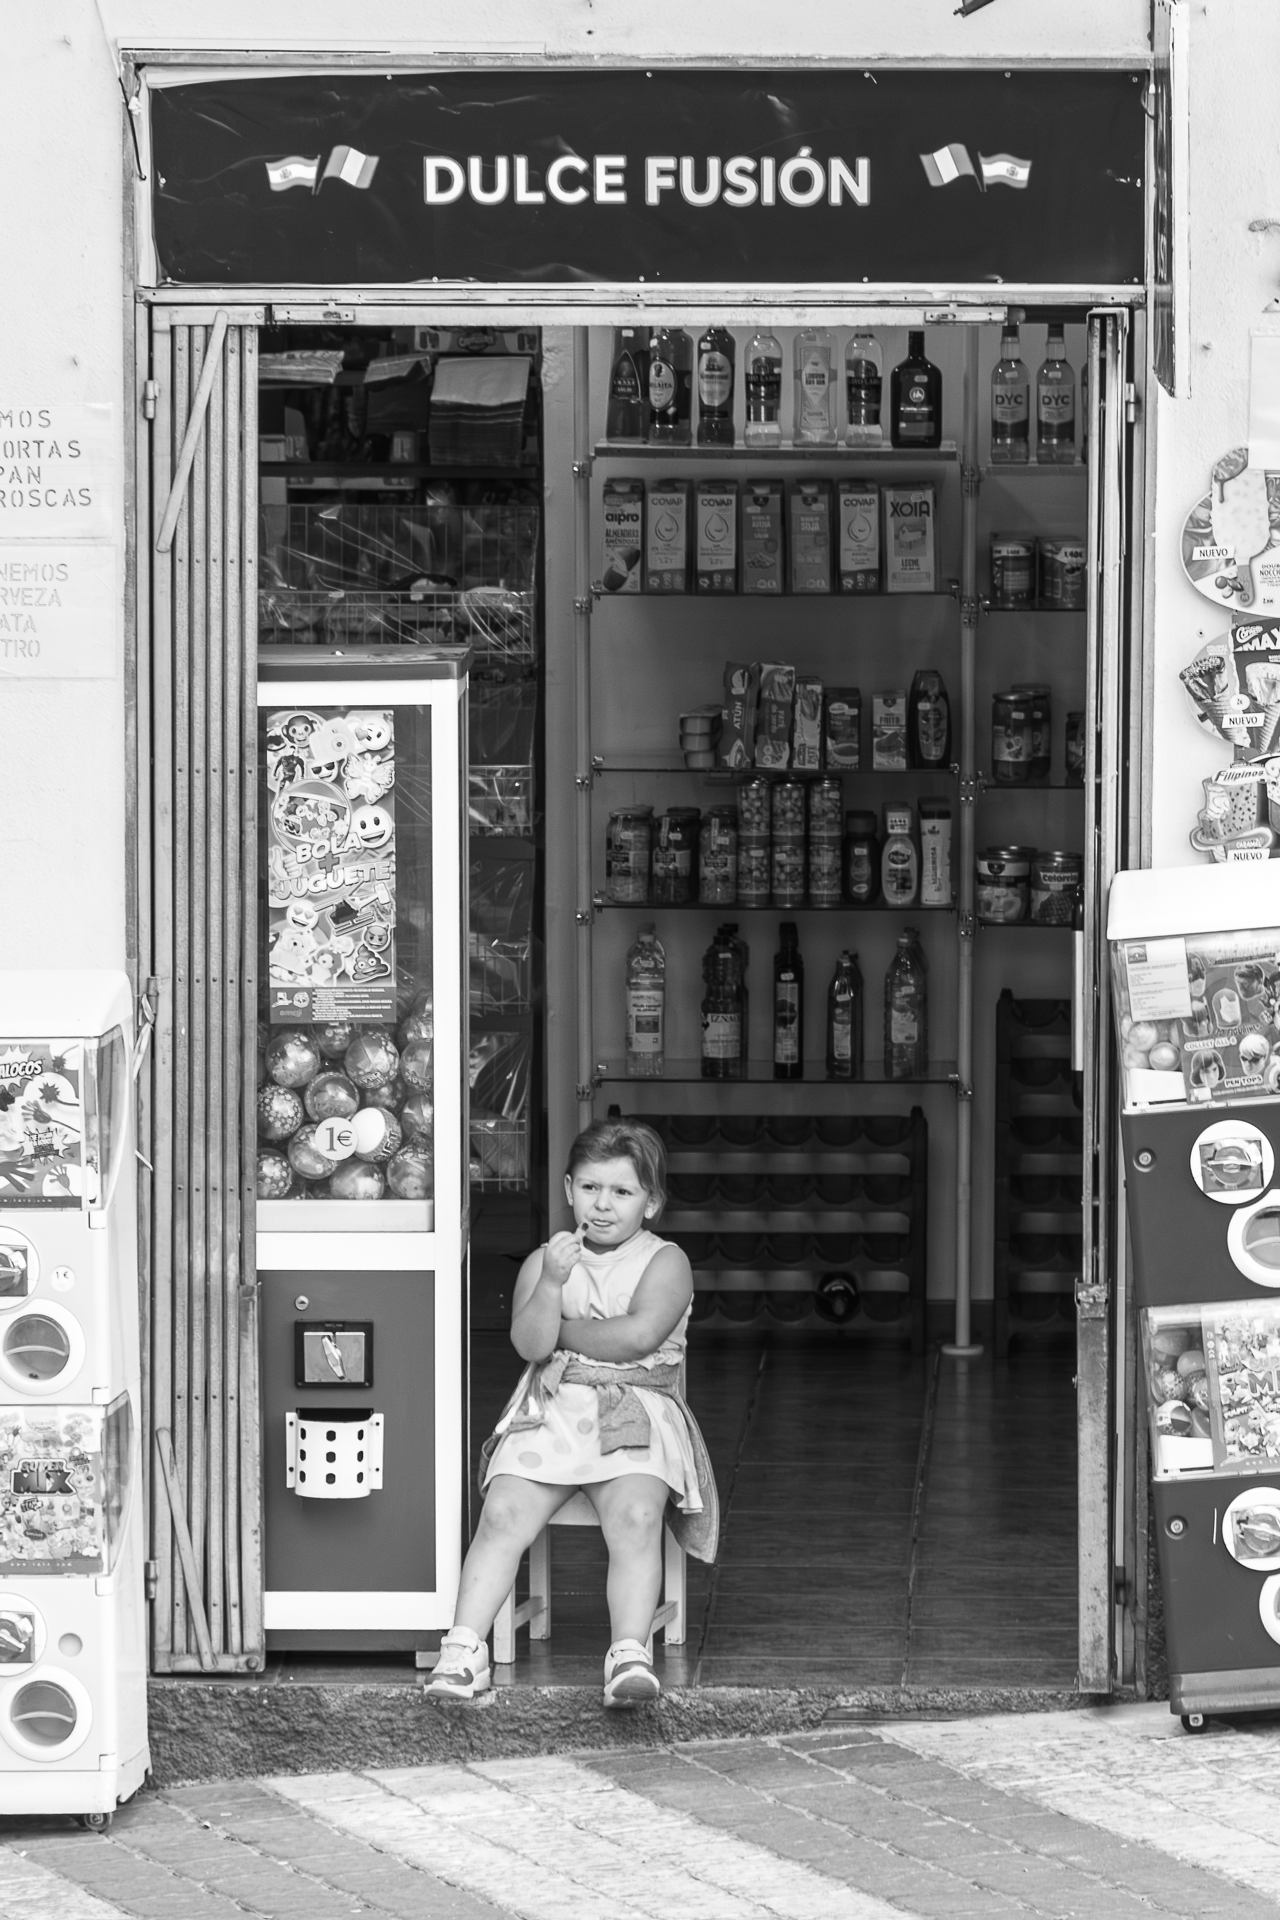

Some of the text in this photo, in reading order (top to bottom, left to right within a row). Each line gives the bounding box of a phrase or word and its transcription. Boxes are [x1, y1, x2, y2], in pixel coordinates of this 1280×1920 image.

[423, 146, 870, 206] DULCE FUSIÓN
[995, 394, 1023, 406] DYC
[1042, 394, 1071, 406] DYC
[0, 409, 51, 428] MOS
[3, 440, 81, 458] ORTAS
[650, 497, 683, 506] COVAP
[701, 498, 733, 507] COVAP
[843, 498, 876, 507] COVAP
[1199, 548, 1228, 558] NUEVO
[1228, 716, 1259, 725] NUEVO
[1215, 769, 1265, 782] Filipinos
[295, 831, 363, 864] BOLA
[1232, 852, 1263, 861] NUEVO
[274, 862, 391, 901] JUGUETE
[1226, 1076, 1262, 1087] PEN TOPS
[325, 1127, 353, 1152] 1€
[21, 1460, 65, 1472] SUPER
[12, 1470, 76, 1494] MIX
